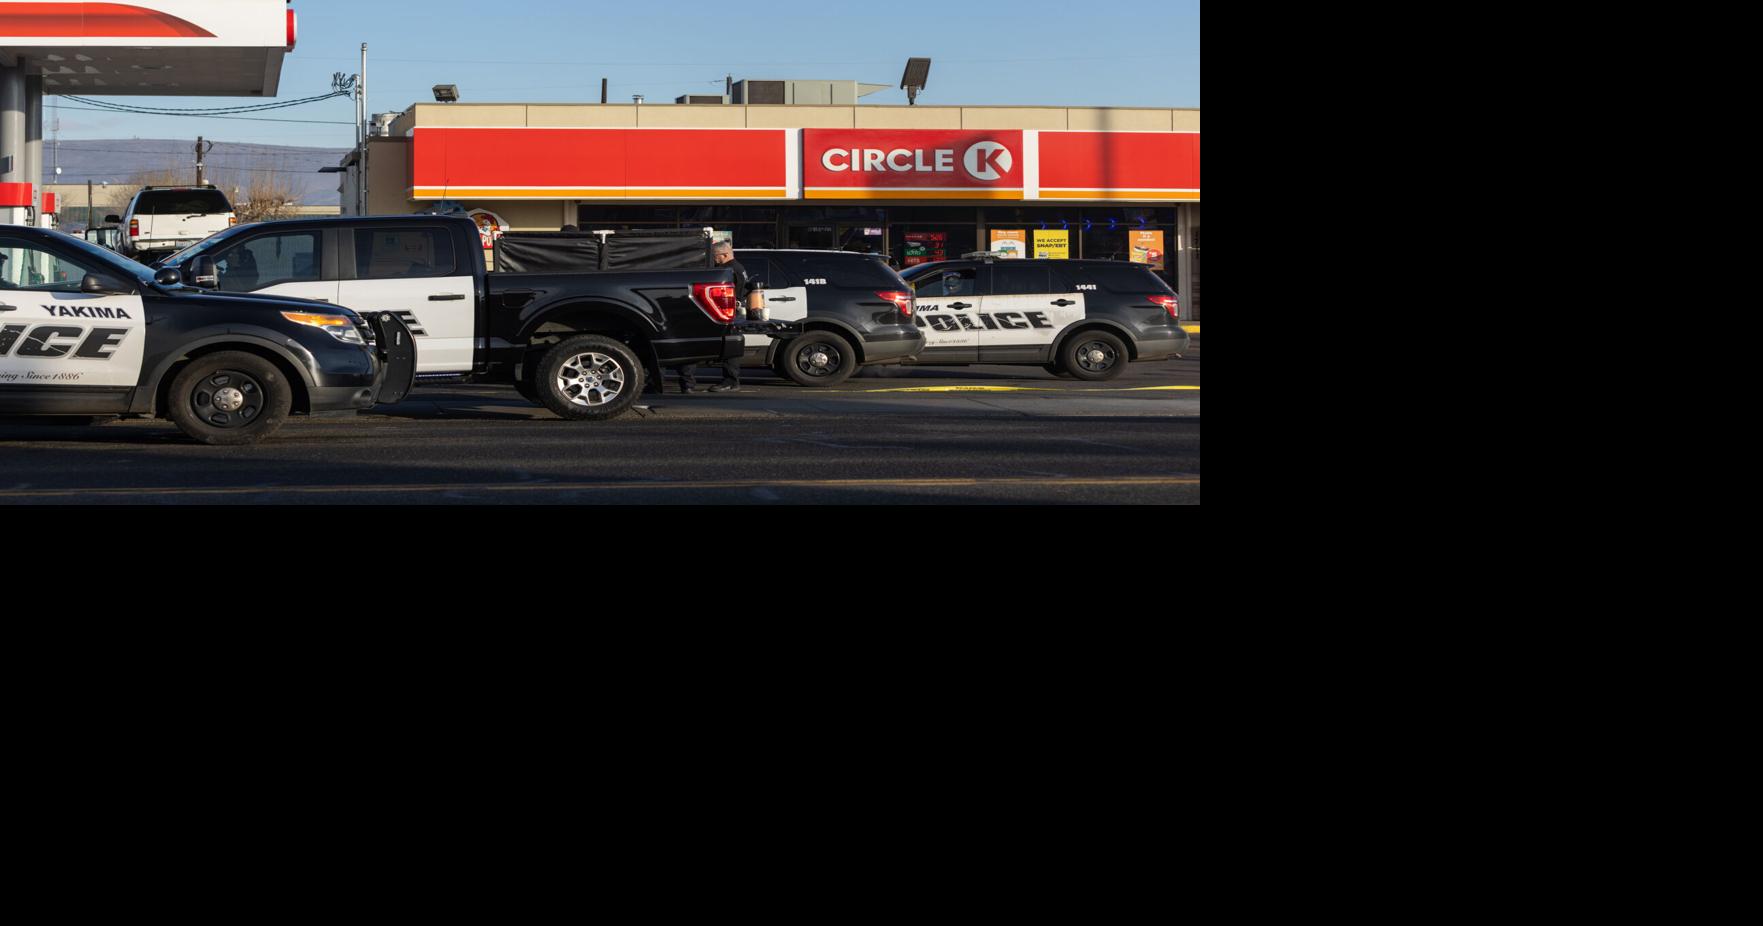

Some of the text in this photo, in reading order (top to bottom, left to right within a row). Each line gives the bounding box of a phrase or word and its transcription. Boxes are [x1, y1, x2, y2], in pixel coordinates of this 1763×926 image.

[821, 147, 1010, 179] CIRCLE K
[40, 304, 132, 319] YAKIMA
[0, 322, 132, 360] ICE
[21, 370, 52, 380] Since
